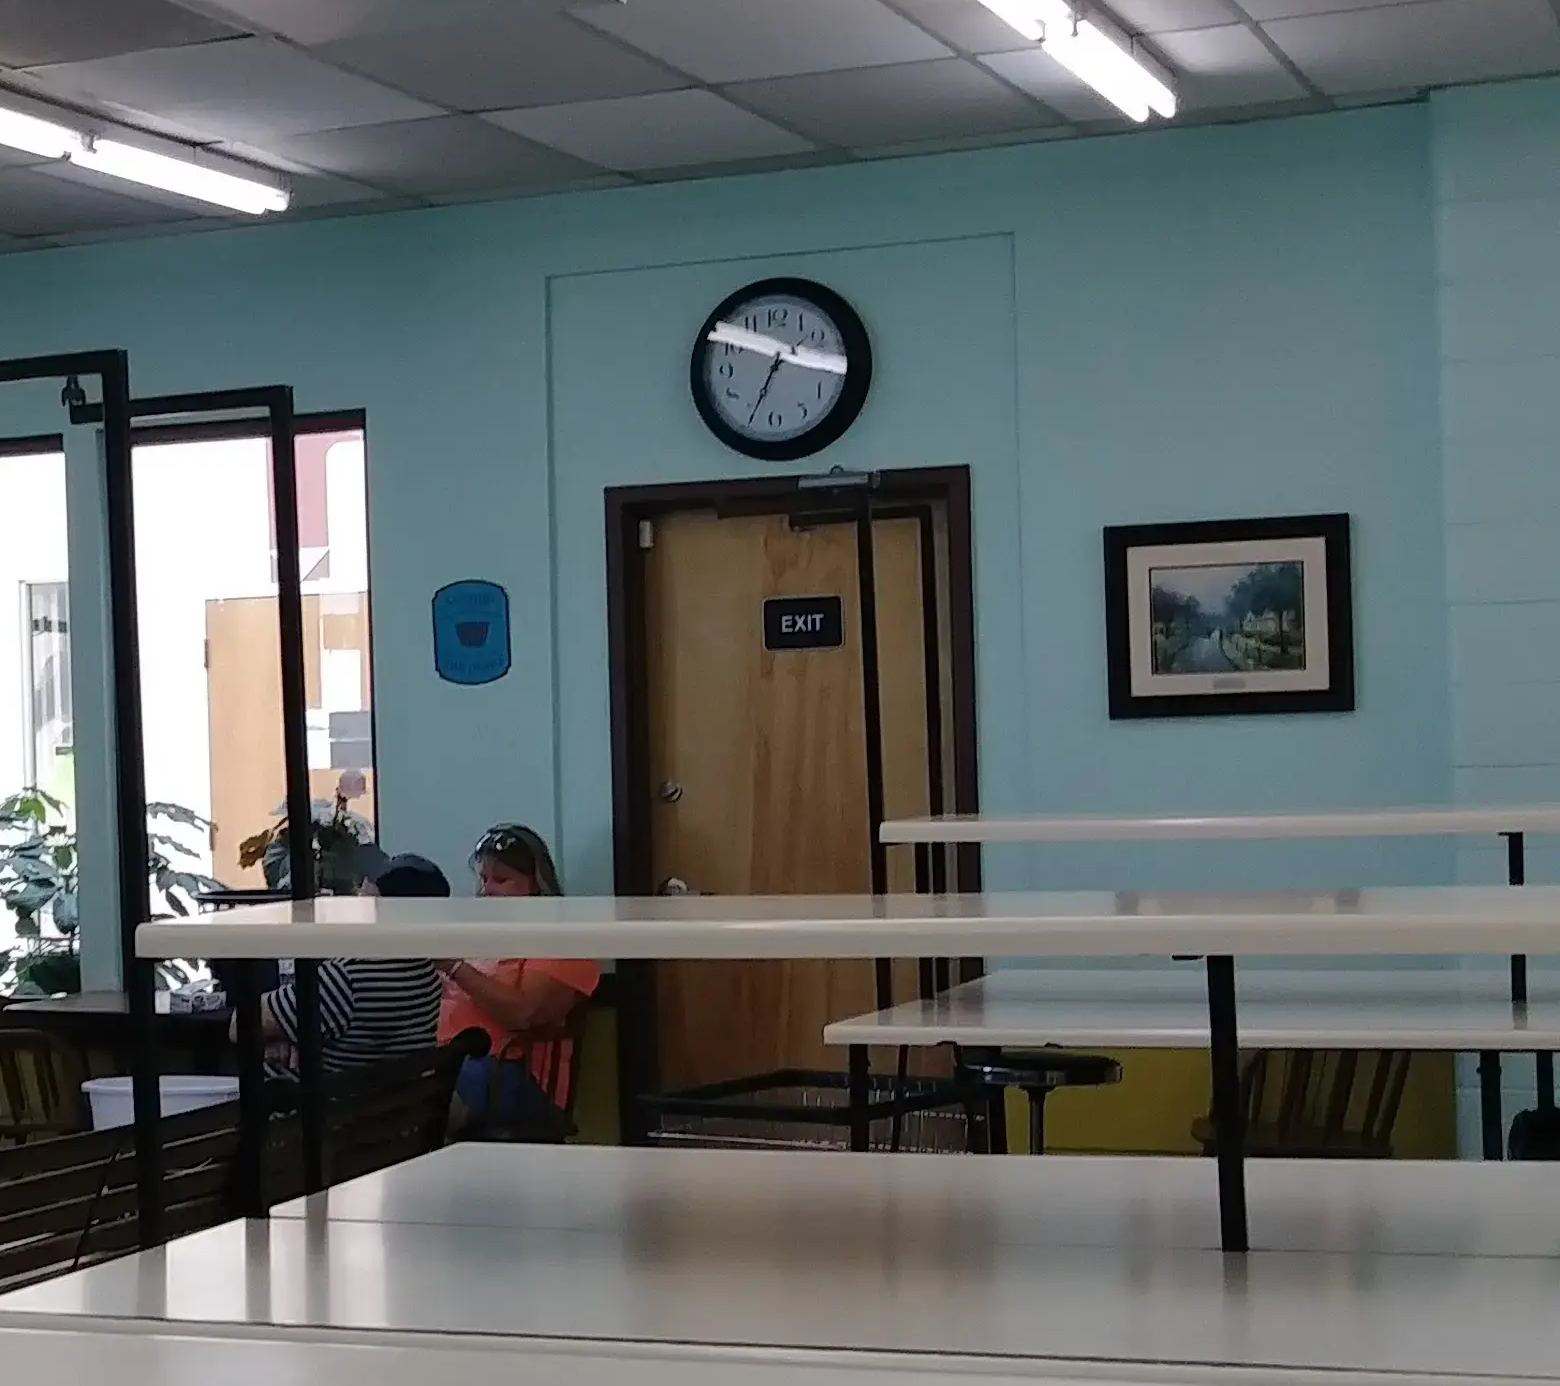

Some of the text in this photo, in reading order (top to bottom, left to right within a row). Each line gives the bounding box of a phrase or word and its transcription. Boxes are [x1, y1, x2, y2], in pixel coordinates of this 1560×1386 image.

[745, 314, 757, 332] 11
[767, 308, 788, 327] 12
[719, 363, 734, 379] 9
[768, 411, 782, 428] 6
[781, 613, 825, 633] EXIT
